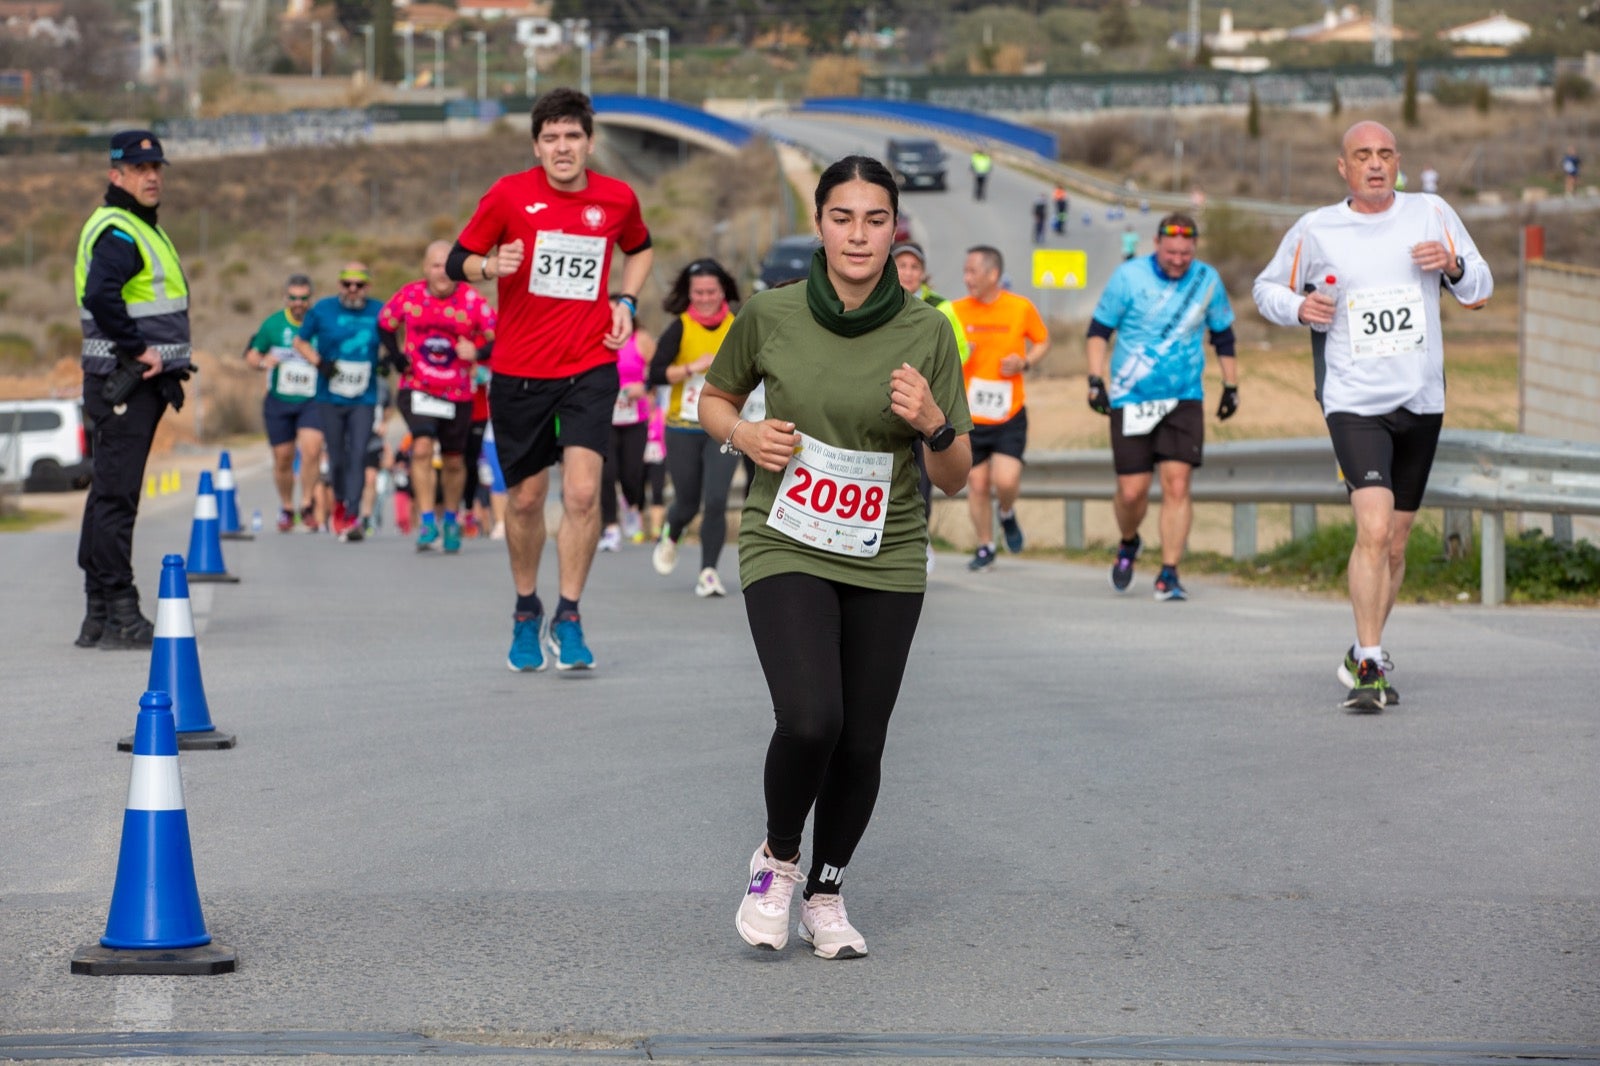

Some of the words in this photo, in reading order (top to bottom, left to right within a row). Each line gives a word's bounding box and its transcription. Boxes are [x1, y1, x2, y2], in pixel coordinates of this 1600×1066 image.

[537, 254, 598, 280] 3152
[1362, 306, 1413, 335] 302
[785, 467, 884, 522] 2098
